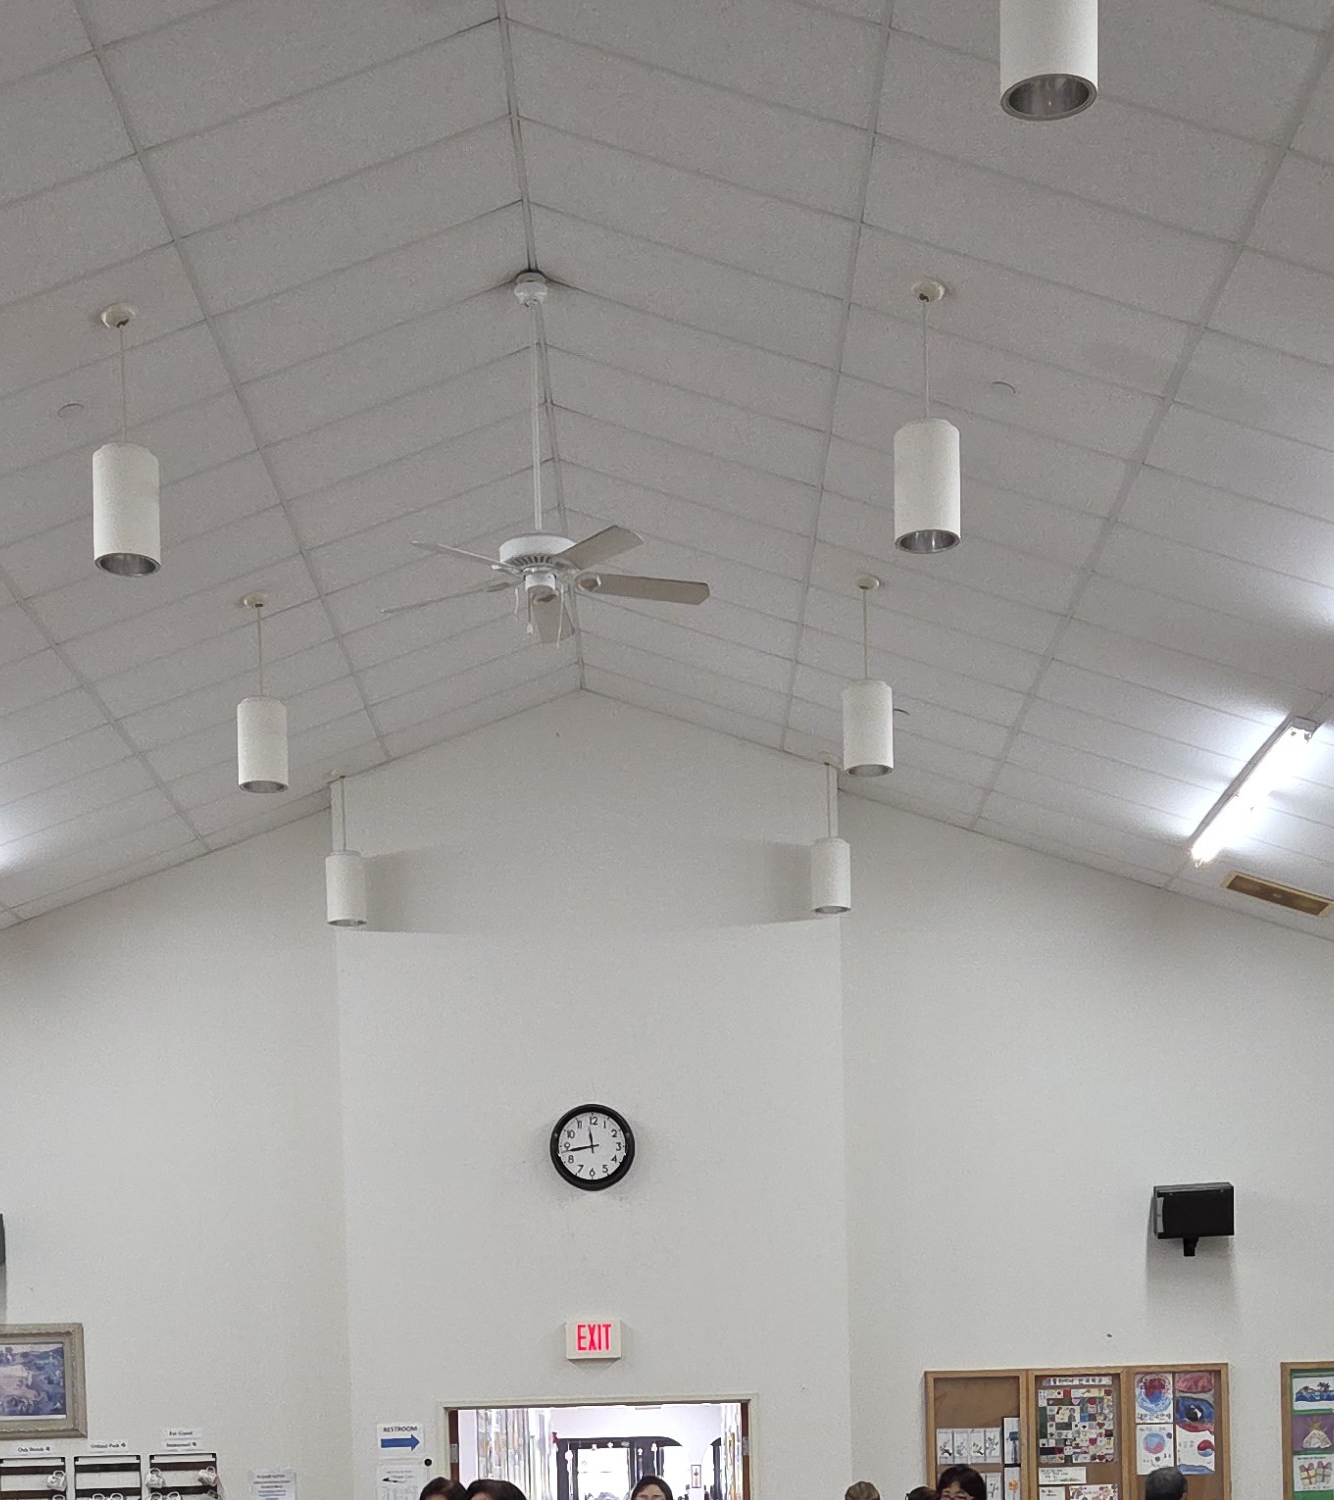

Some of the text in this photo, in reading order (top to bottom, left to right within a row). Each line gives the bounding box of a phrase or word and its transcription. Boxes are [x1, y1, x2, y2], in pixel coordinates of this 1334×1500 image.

[577, 1120, 583, 1129] 11
[589, 1116, 598, 1125] 12
[567, 1130, 576, 1139] 10
[611, 1129, 618, 1137] 2
[564, 1142, 571, 1151] 9
[616, 1142, 622, 1151] 3
[568, 1155, 574, 1164] 8
[610, 1154, 617, 1163] 4
[577, 1165, 584, 1173] 7
[589, 1168, 596, 1176] 6
[602, 1165, 608, 1173] 5
[578, 1324, 611, 1350] EXIT
